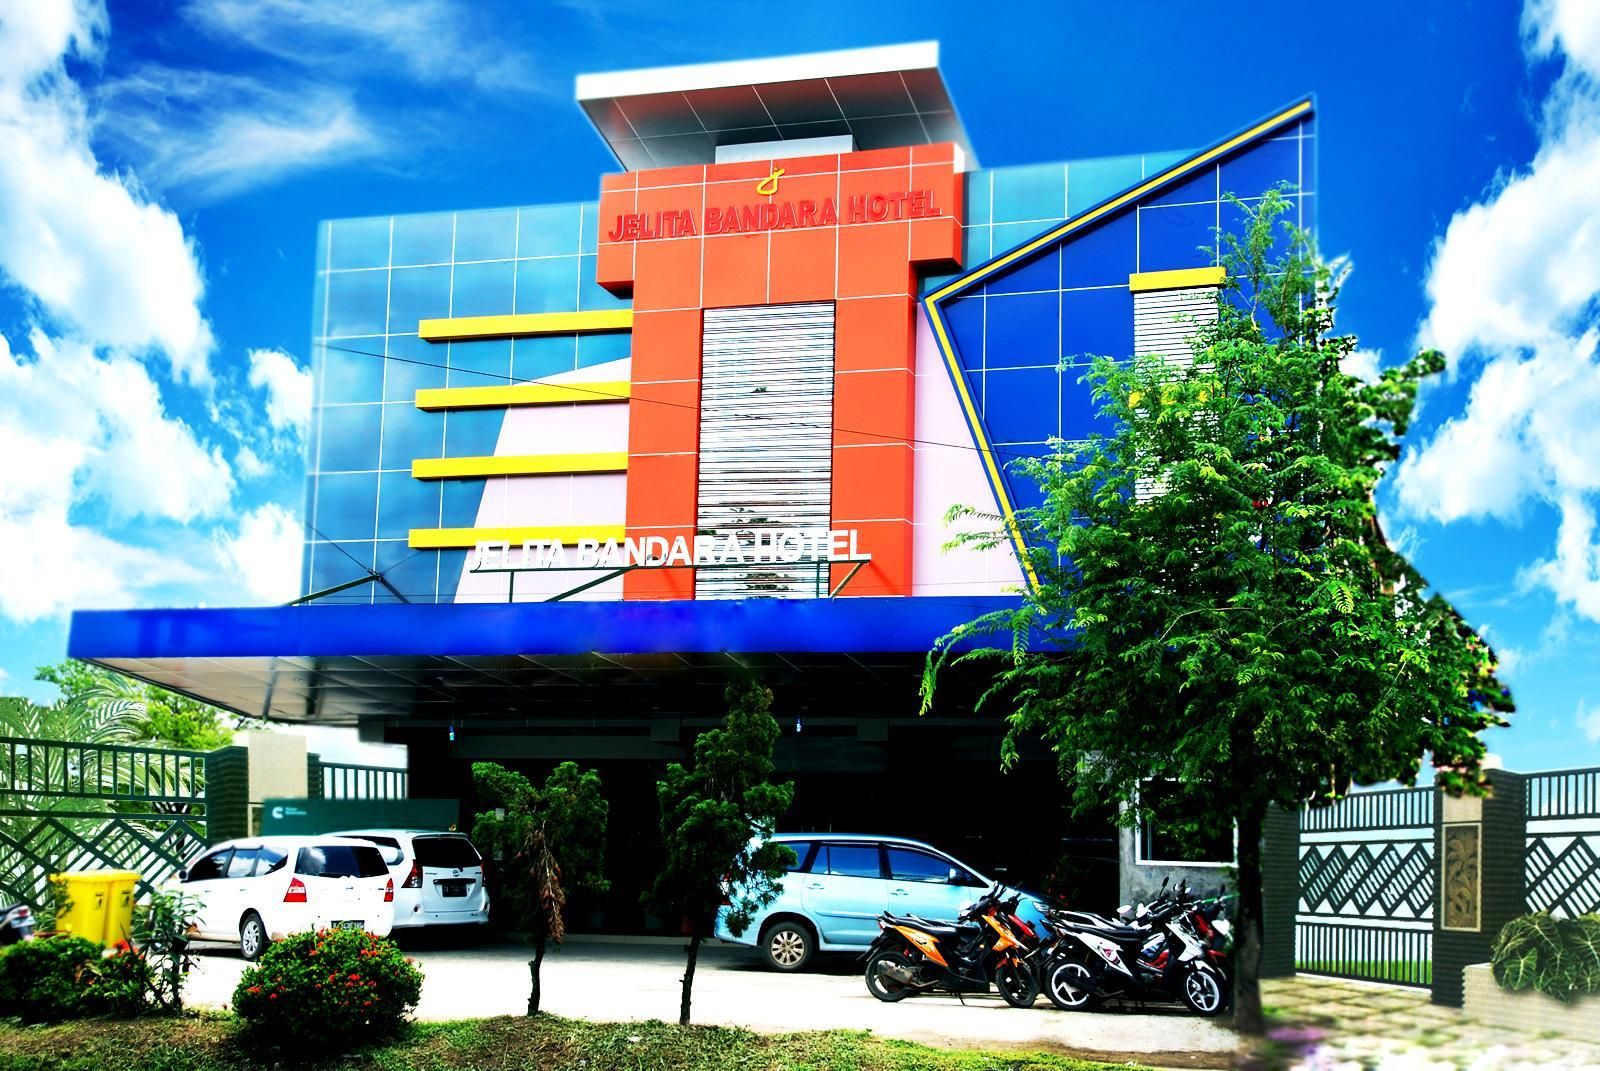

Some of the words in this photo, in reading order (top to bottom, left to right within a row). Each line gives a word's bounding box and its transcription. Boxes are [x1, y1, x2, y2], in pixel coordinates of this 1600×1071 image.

[608, 205, 697, 241] JELITA
[706, 198, 838, 233] BANDARA
[849, 190, 942, 222] HOTEL
[471, 539, 568, 570] JELITA
[577, 533, 746, 568] BANDARA
[749, 529, 872, 563] HOTEL
